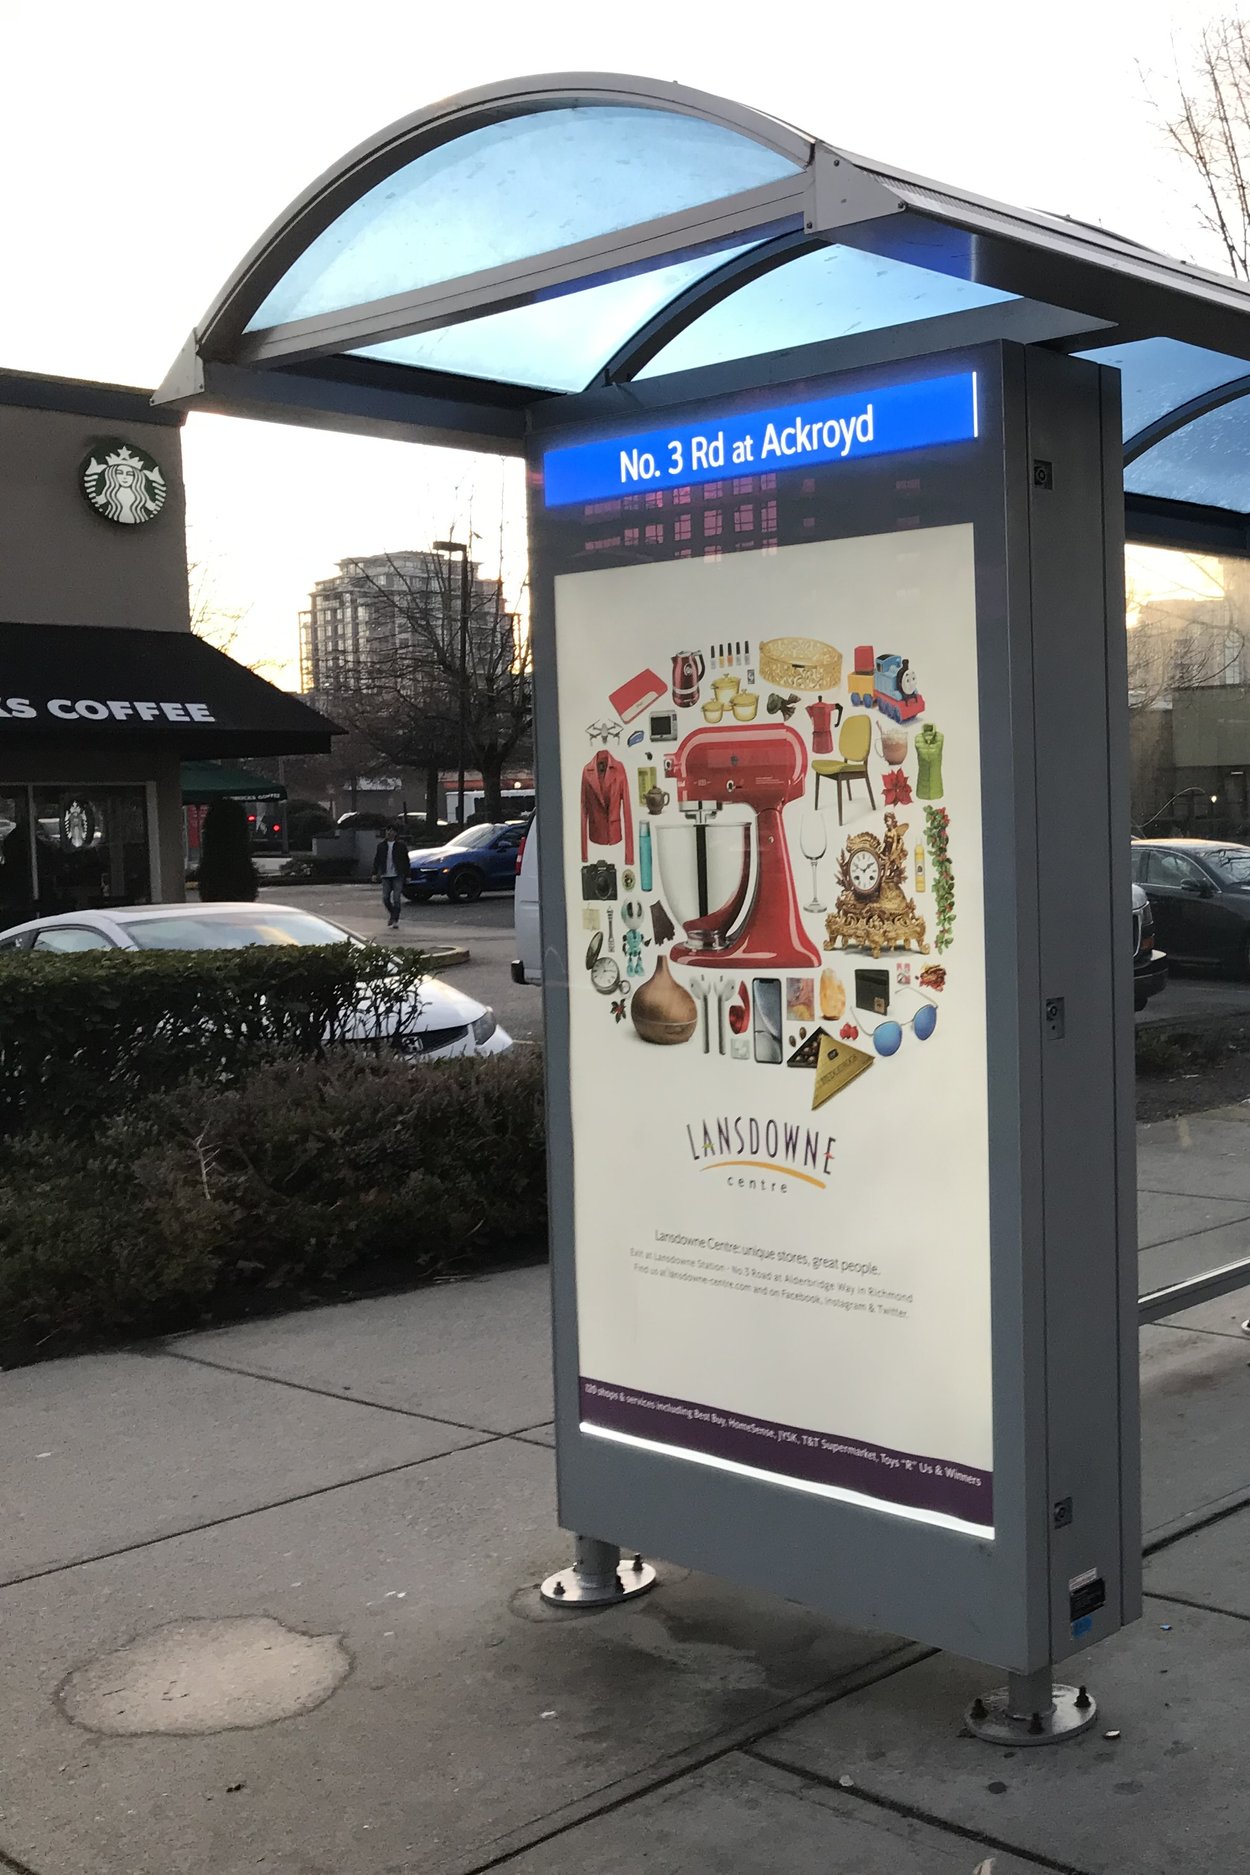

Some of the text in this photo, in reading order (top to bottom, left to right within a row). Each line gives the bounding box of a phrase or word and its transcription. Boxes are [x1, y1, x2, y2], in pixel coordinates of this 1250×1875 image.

[620, 404, 874, 482] No. 3 Rd at Ackroyd
[47, 699, 216, 722] COFFEE
[686, 1117, 837, 1175] LANSDOWNE
[727, 1177, 788, 1193] centre
[655, 1229, 706, 1249] Lansdowne
[742, 1246, 775, 1261] unique
[777, 1250, 810, 1267] stores,
[811, 1256, 838, 1270] great
[841, 1261, 881, 1276] people.
[694, 1409, 711, 1421] Best
[801, 1435, 820, 1447] T&T
[880, 1453, 901, 1469] Toys
[919, 1462, 933, 1474] Us
[934, 1464, 943, 1476] &
[944, 1466, 982, 1487] Winners
